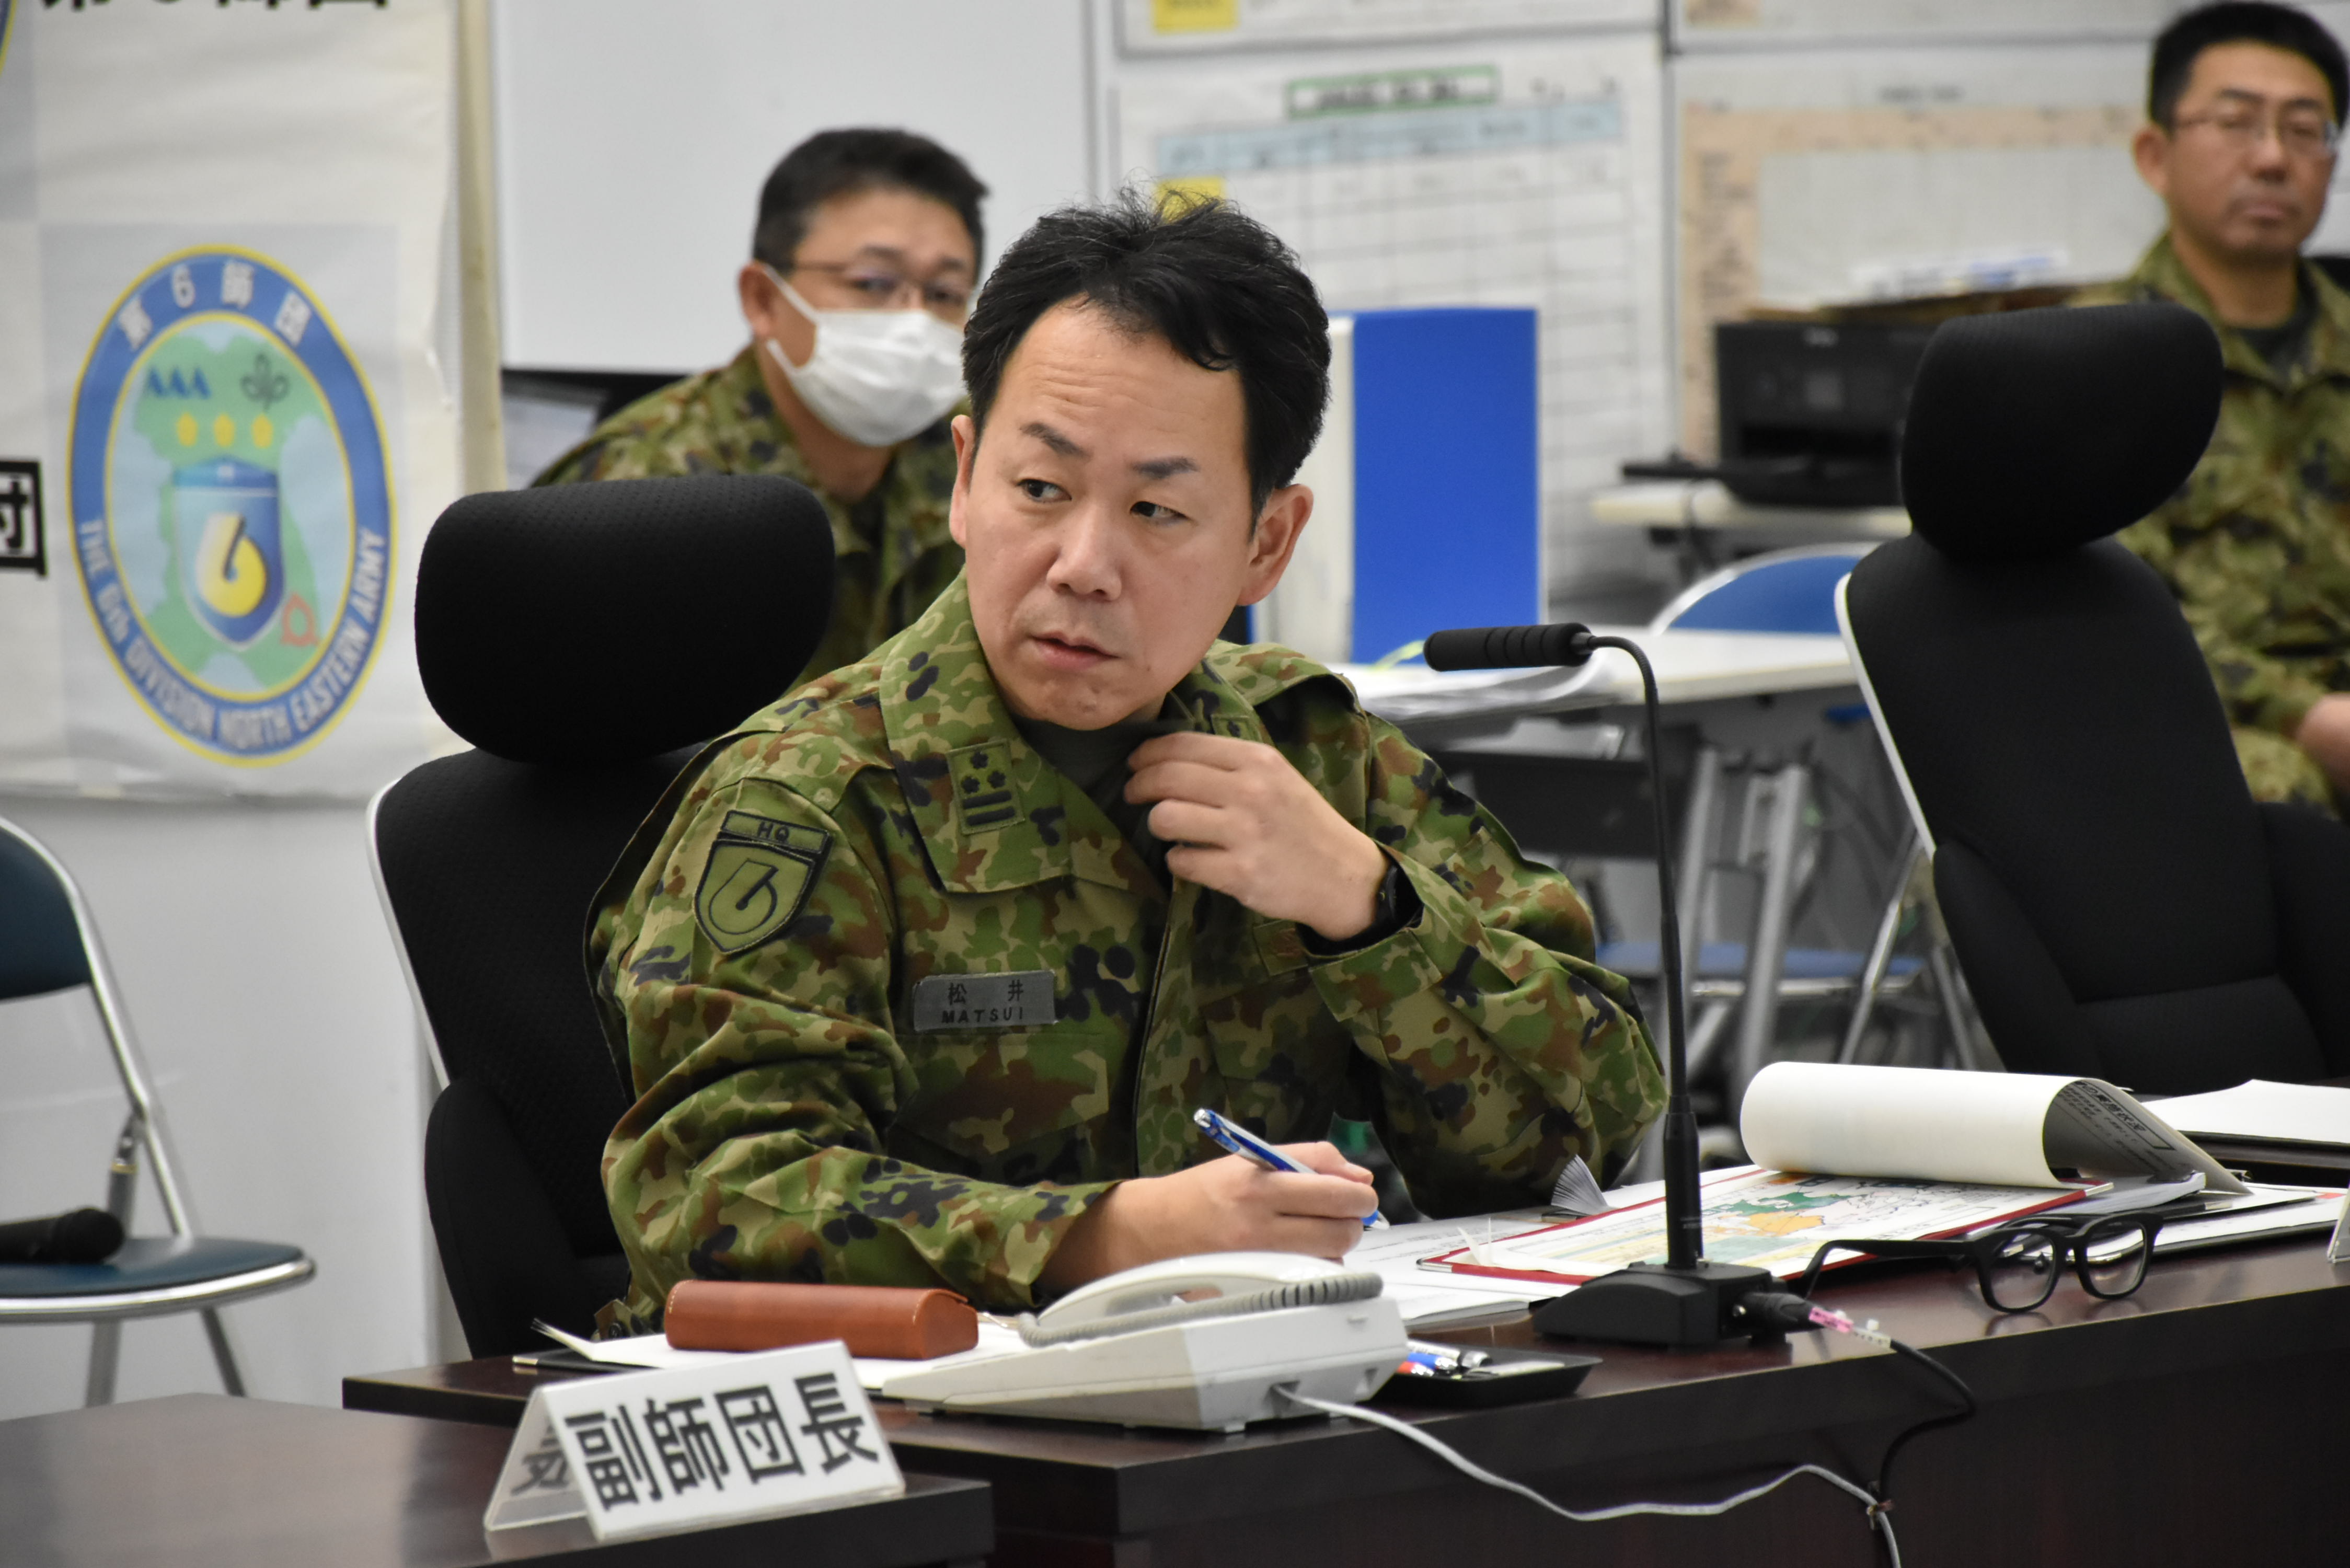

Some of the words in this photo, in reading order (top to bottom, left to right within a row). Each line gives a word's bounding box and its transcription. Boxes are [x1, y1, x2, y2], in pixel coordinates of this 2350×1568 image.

[80, 519, 111, 580] THE
[125, 635, 215, 737] DIVISION
[219, 705, 293, 750] NORTH
[289, 617, 370, 733] EASTERN
[349, 526, 386, 624] ARMY
[758, 821, 789, 844] HQ
[947, 978, 1024, 1006] 松井
[941, 1006, 1023, 1024] MATSUI
[565, 1372, 880, 1513] 副師団長
